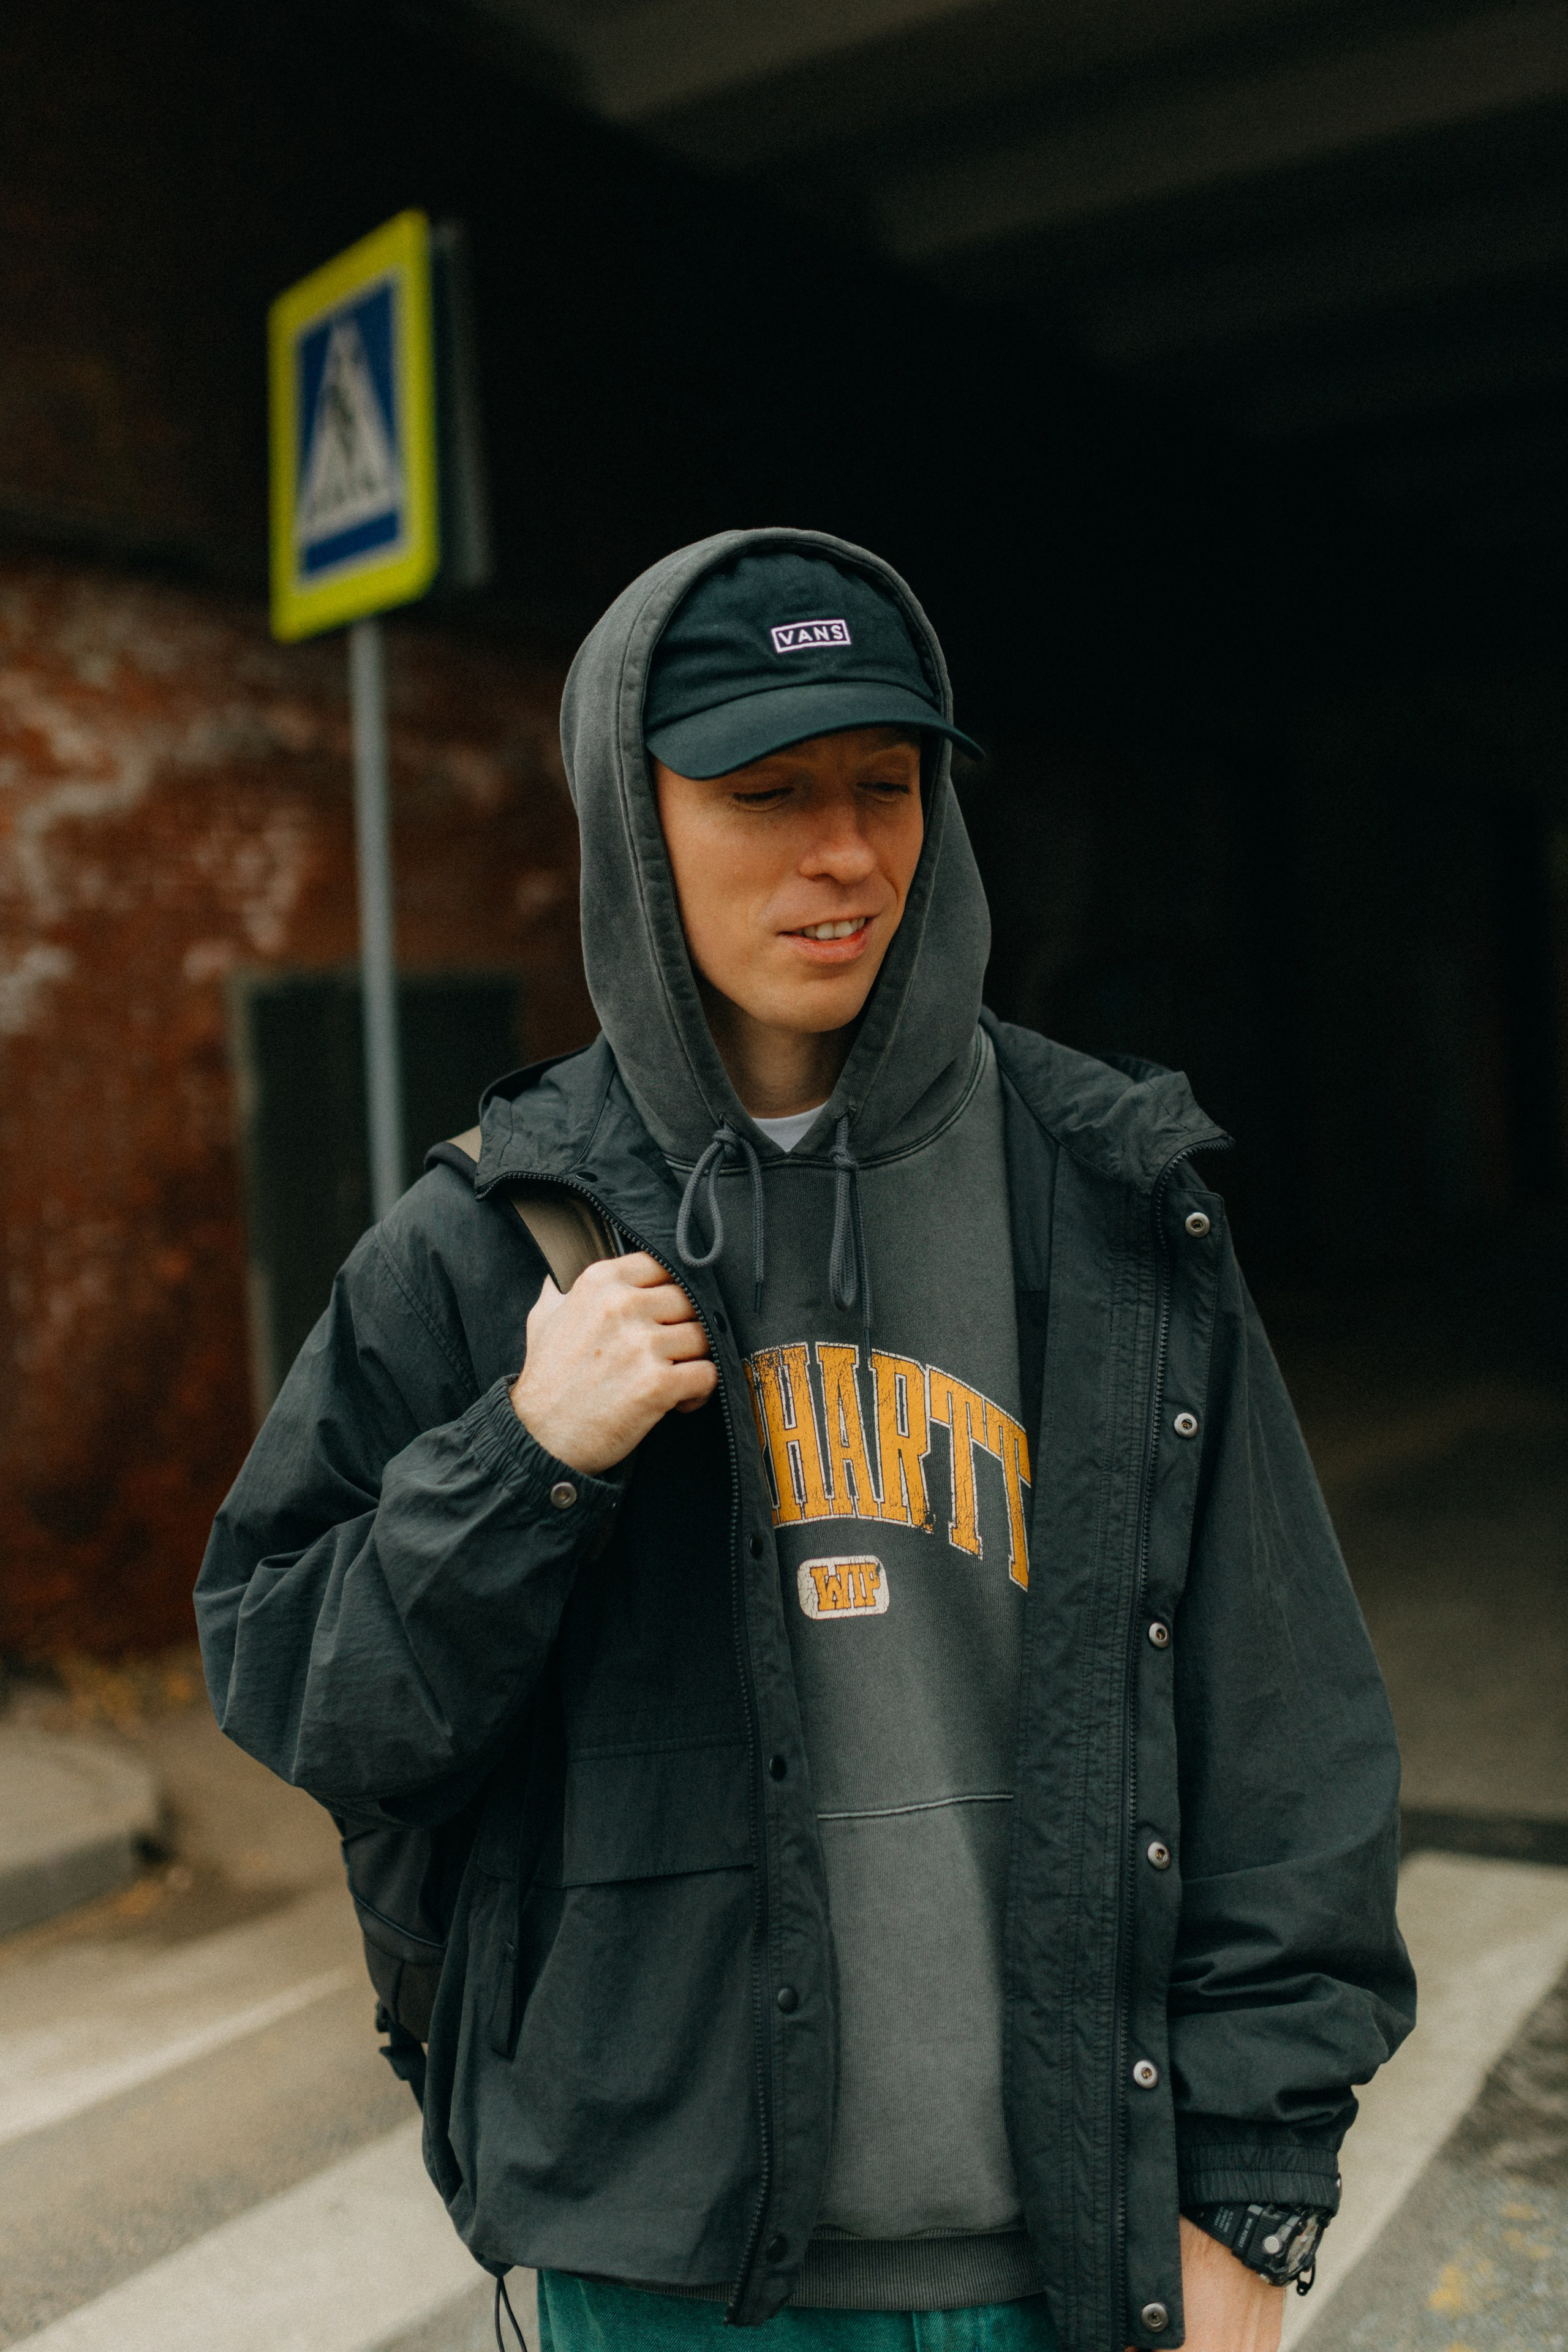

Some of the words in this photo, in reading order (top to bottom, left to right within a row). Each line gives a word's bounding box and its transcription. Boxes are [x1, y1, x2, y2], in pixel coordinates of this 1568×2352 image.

[778, 625, 843, 645] VANS
[742, 1341, 1031, 1593] HARTT
[810, 1562, 880, 1611] WIP
[1245, 2217, 1253, 2230] MUD
[1238, 2229, 1248, 2248] RESIST
